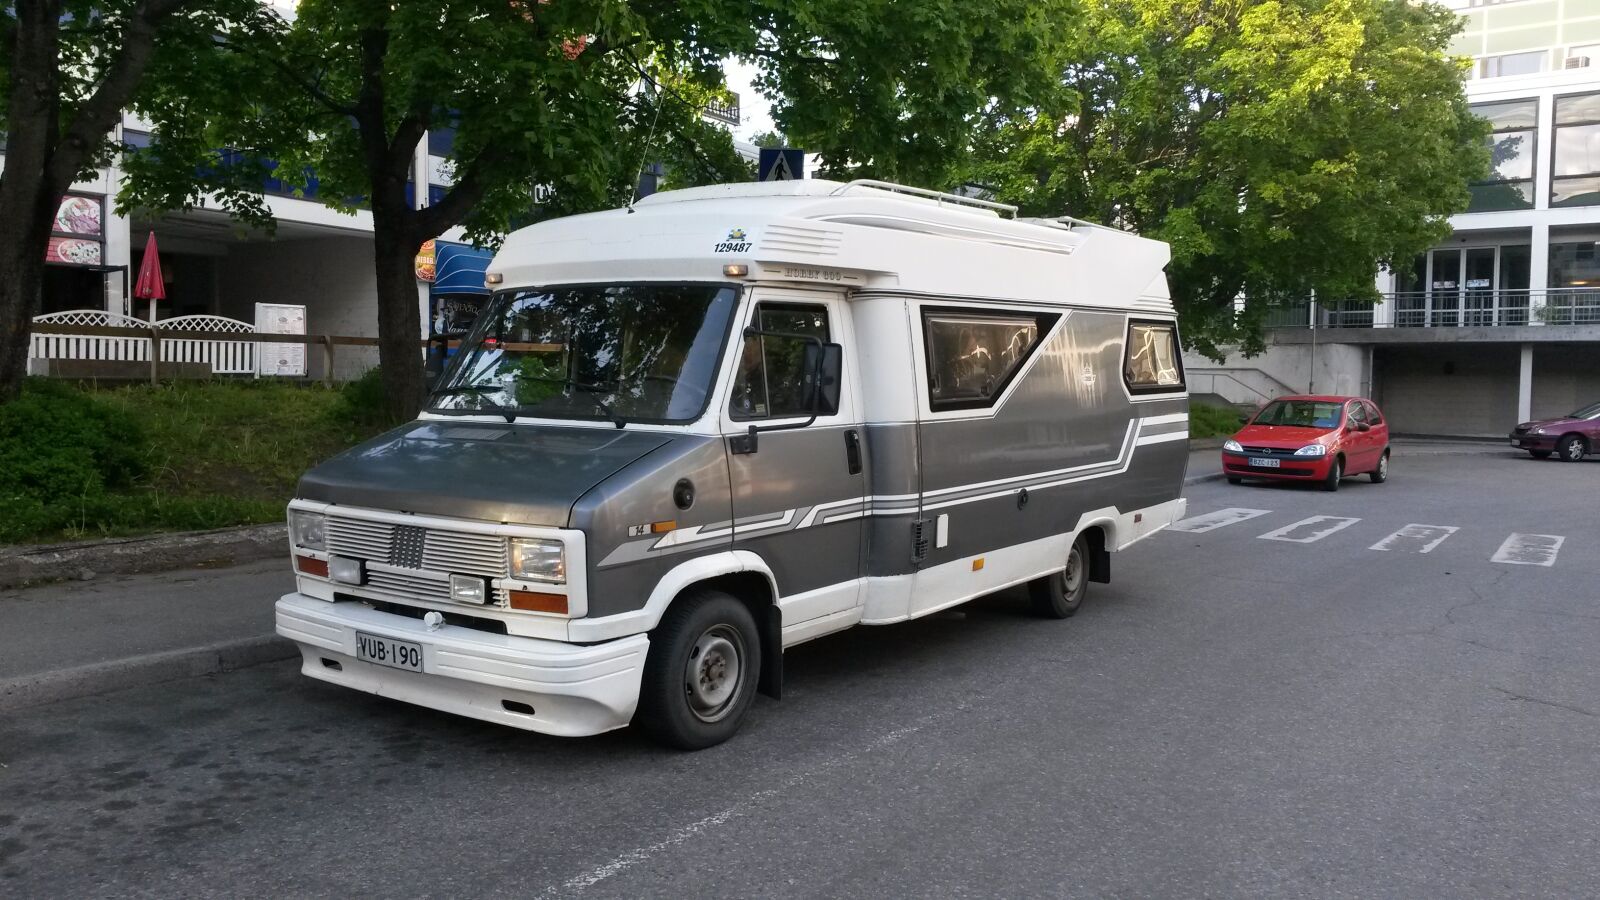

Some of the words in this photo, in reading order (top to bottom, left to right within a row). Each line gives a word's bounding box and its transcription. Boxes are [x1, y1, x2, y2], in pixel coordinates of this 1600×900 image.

[714, 242, 753, 253] 129487
[784, 268, 820, 280] HOBBY
[635, 524, 645, 536] 14
[359, 636, 419, 668] VUB-190
